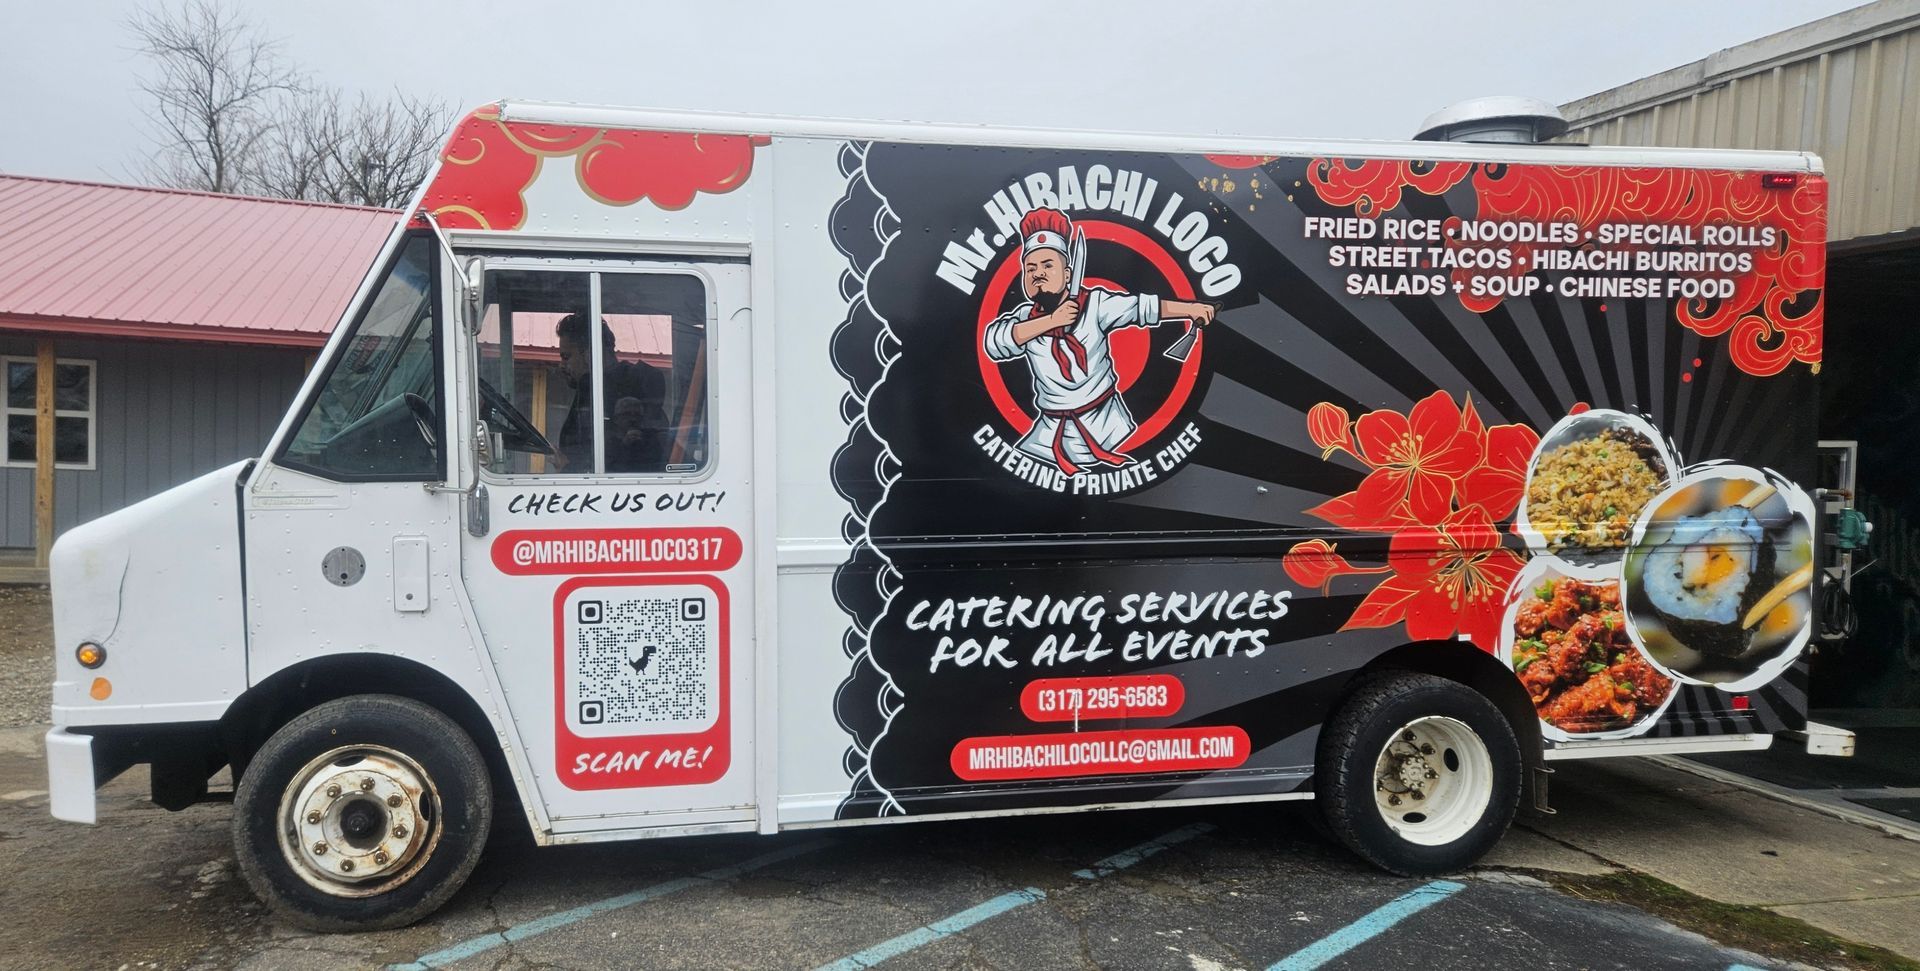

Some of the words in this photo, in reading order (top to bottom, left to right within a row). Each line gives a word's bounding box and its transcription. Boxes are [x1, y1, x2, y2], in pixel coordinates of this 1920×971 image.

[1153, 192, 1242, 297] LOCO
[1304, 217, 1376, 241] FRIED
[1383, 219, 1440, 242] RICE
[1461, 221, 1579, 244] NOODLES
[1598, 223, 1696, 246] SPECIAL
[1703, 225, 1776, 248] ROLLS
[1328, 245, 1422, 268] STREET
[1427, 246, 1513, 270] TACOS
[1532, 249, 1631, 272] HIBACHI
[1640, 250, 1752, 274] BURRITOS
[1346, 273, 1446, 296] SALADS
[1470, 275, 1540, 298] SOUP
[1559, 276, 1661, 299] CHINESE
[1667, 278, 1735, 299] FOOD
[972, 423, 1067, 493] CATERING
[1073, 454, 1157, 496] PRIVATE
[1155, 422, 1204, 472] CHEF
[507, 492, 602, 516] CHECK
[610, 493, 646, 512] US
[655, 491, 727, 512] OUT!
[512, 537, 723, 566] @MRHIBACHILOCO317
[905, 594, 1106, 632] CATERING
[1116, 590, 1294, 625] SERVICES
[929, 635, 1018, 674] FOR
[1031, 634, 1114, 668] ALL
[1122, 628, 1271, 662] EVENTS
[1087, 685, 1168, 710] 295-6583
[573, 750, 650, 774] SCAN
[654, 746, 713, 769] ME!
[969, 736, 1235, 770] MRHIBACHILOCOLLC@GMAIL.COM
